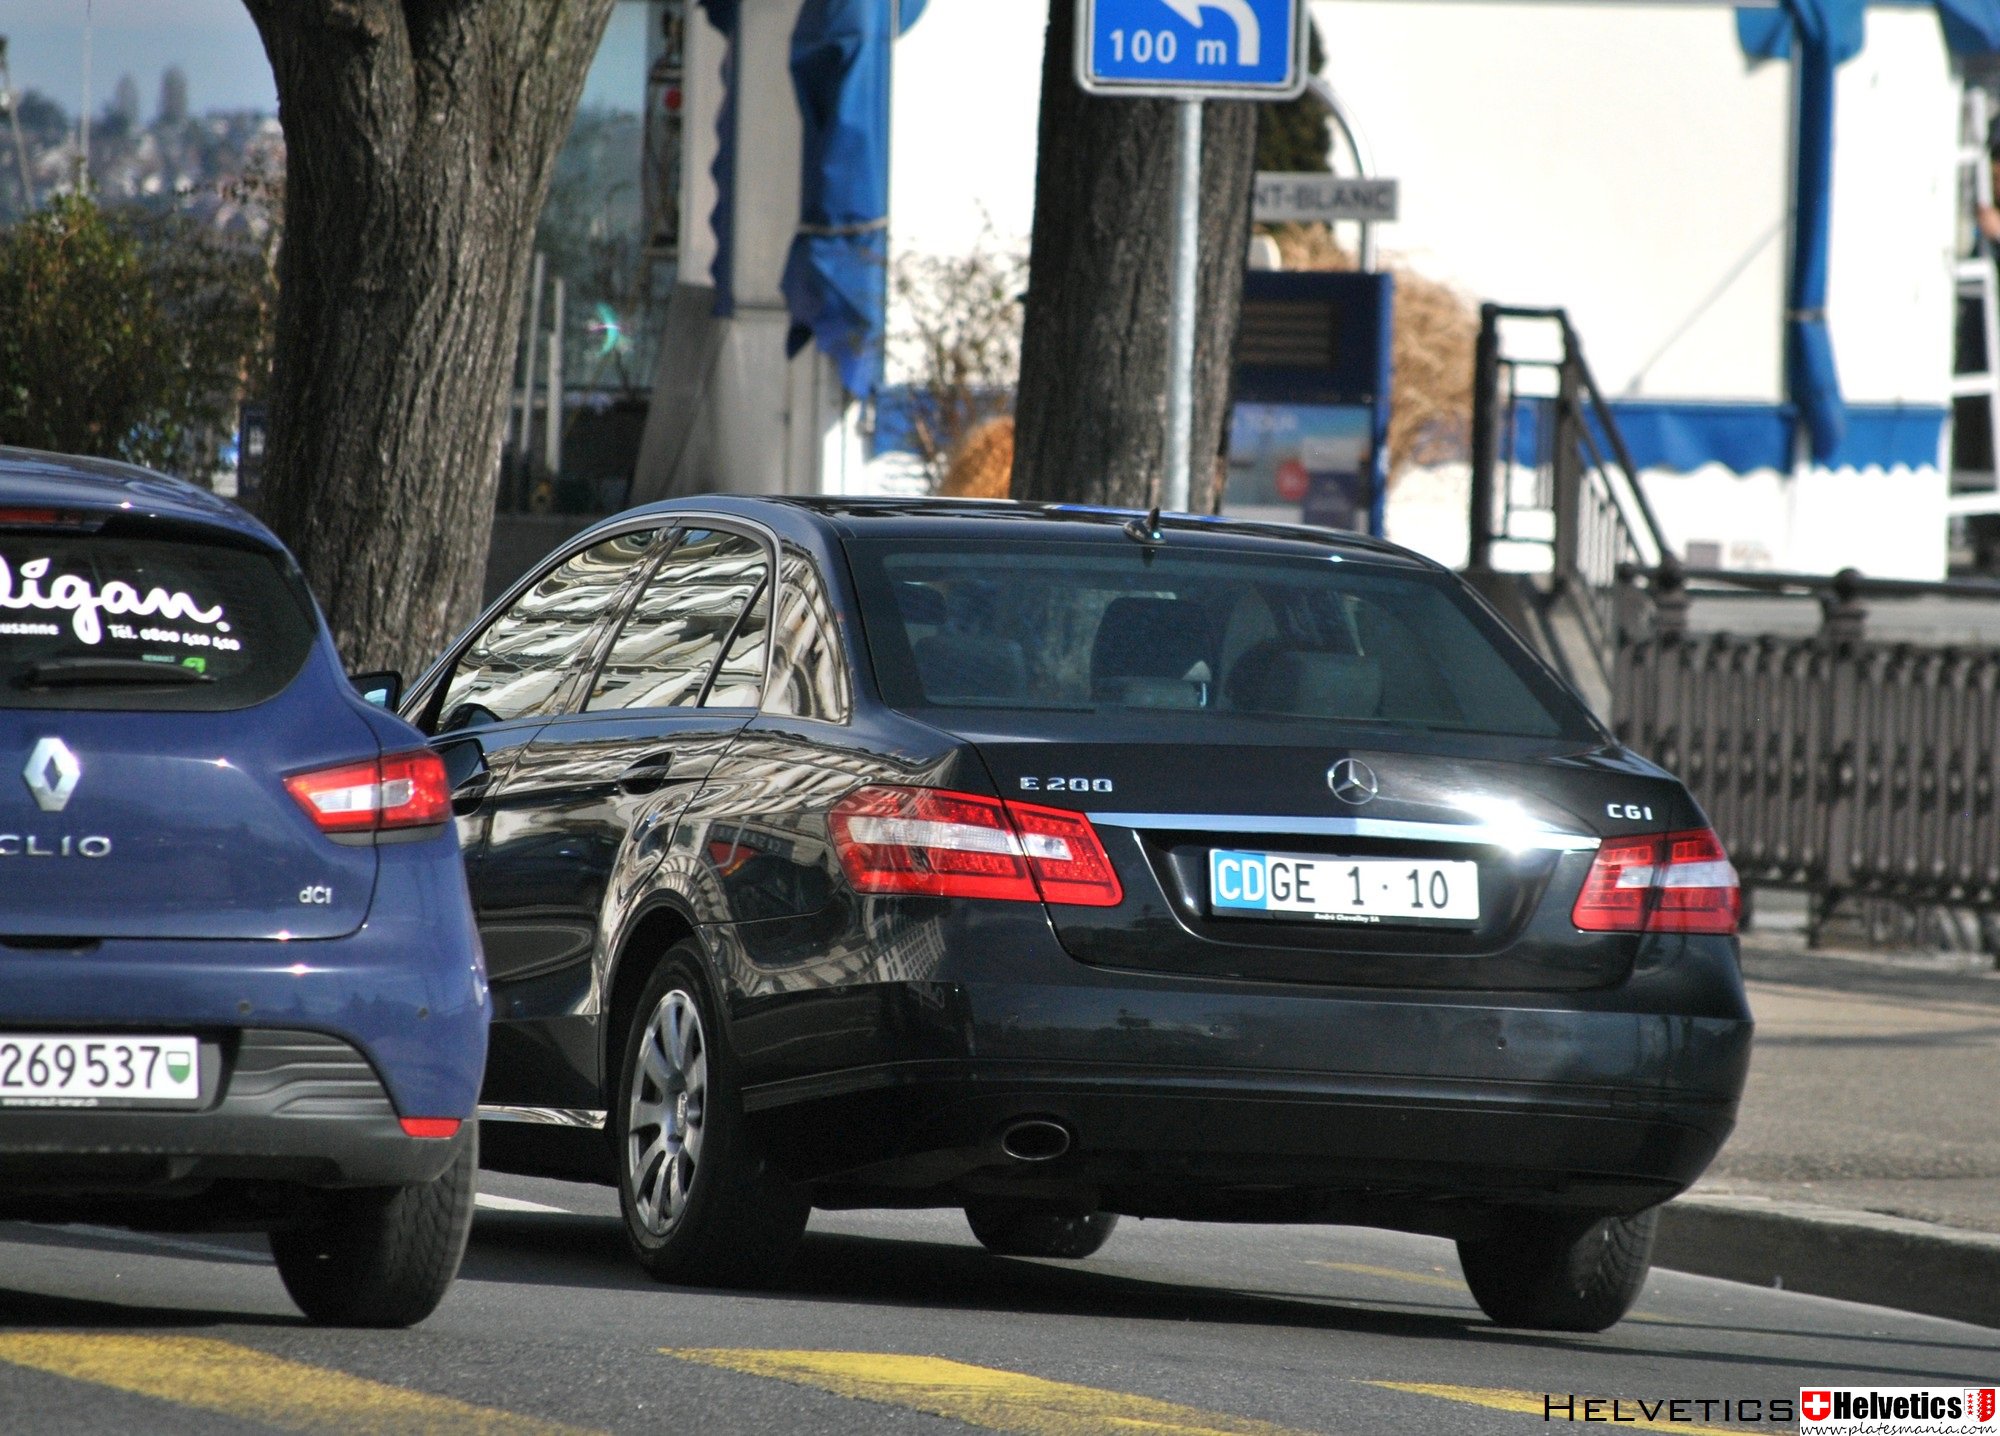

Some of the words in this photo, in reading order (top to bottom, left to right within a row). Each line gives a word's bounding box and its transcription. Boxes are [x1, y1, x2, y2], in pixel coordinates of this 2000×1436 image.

[1109, 29, 1177, 64] 100
[1196, 39, 1228, 65] m
[0, 624, 59, 636] usanne
[1020, 777, 1040, 790] E
[1046, 777, 1113, 792] 200
[1606, 803, 1653, 820] CGI
[0, 834, 112, 858] CLIO
[1217, 858, 1265, 902] CD
[1270, 862, 1316, 903] GE
[0, 1043, 76, 1088] 269
[86, 1044, 161, 1089] 537
